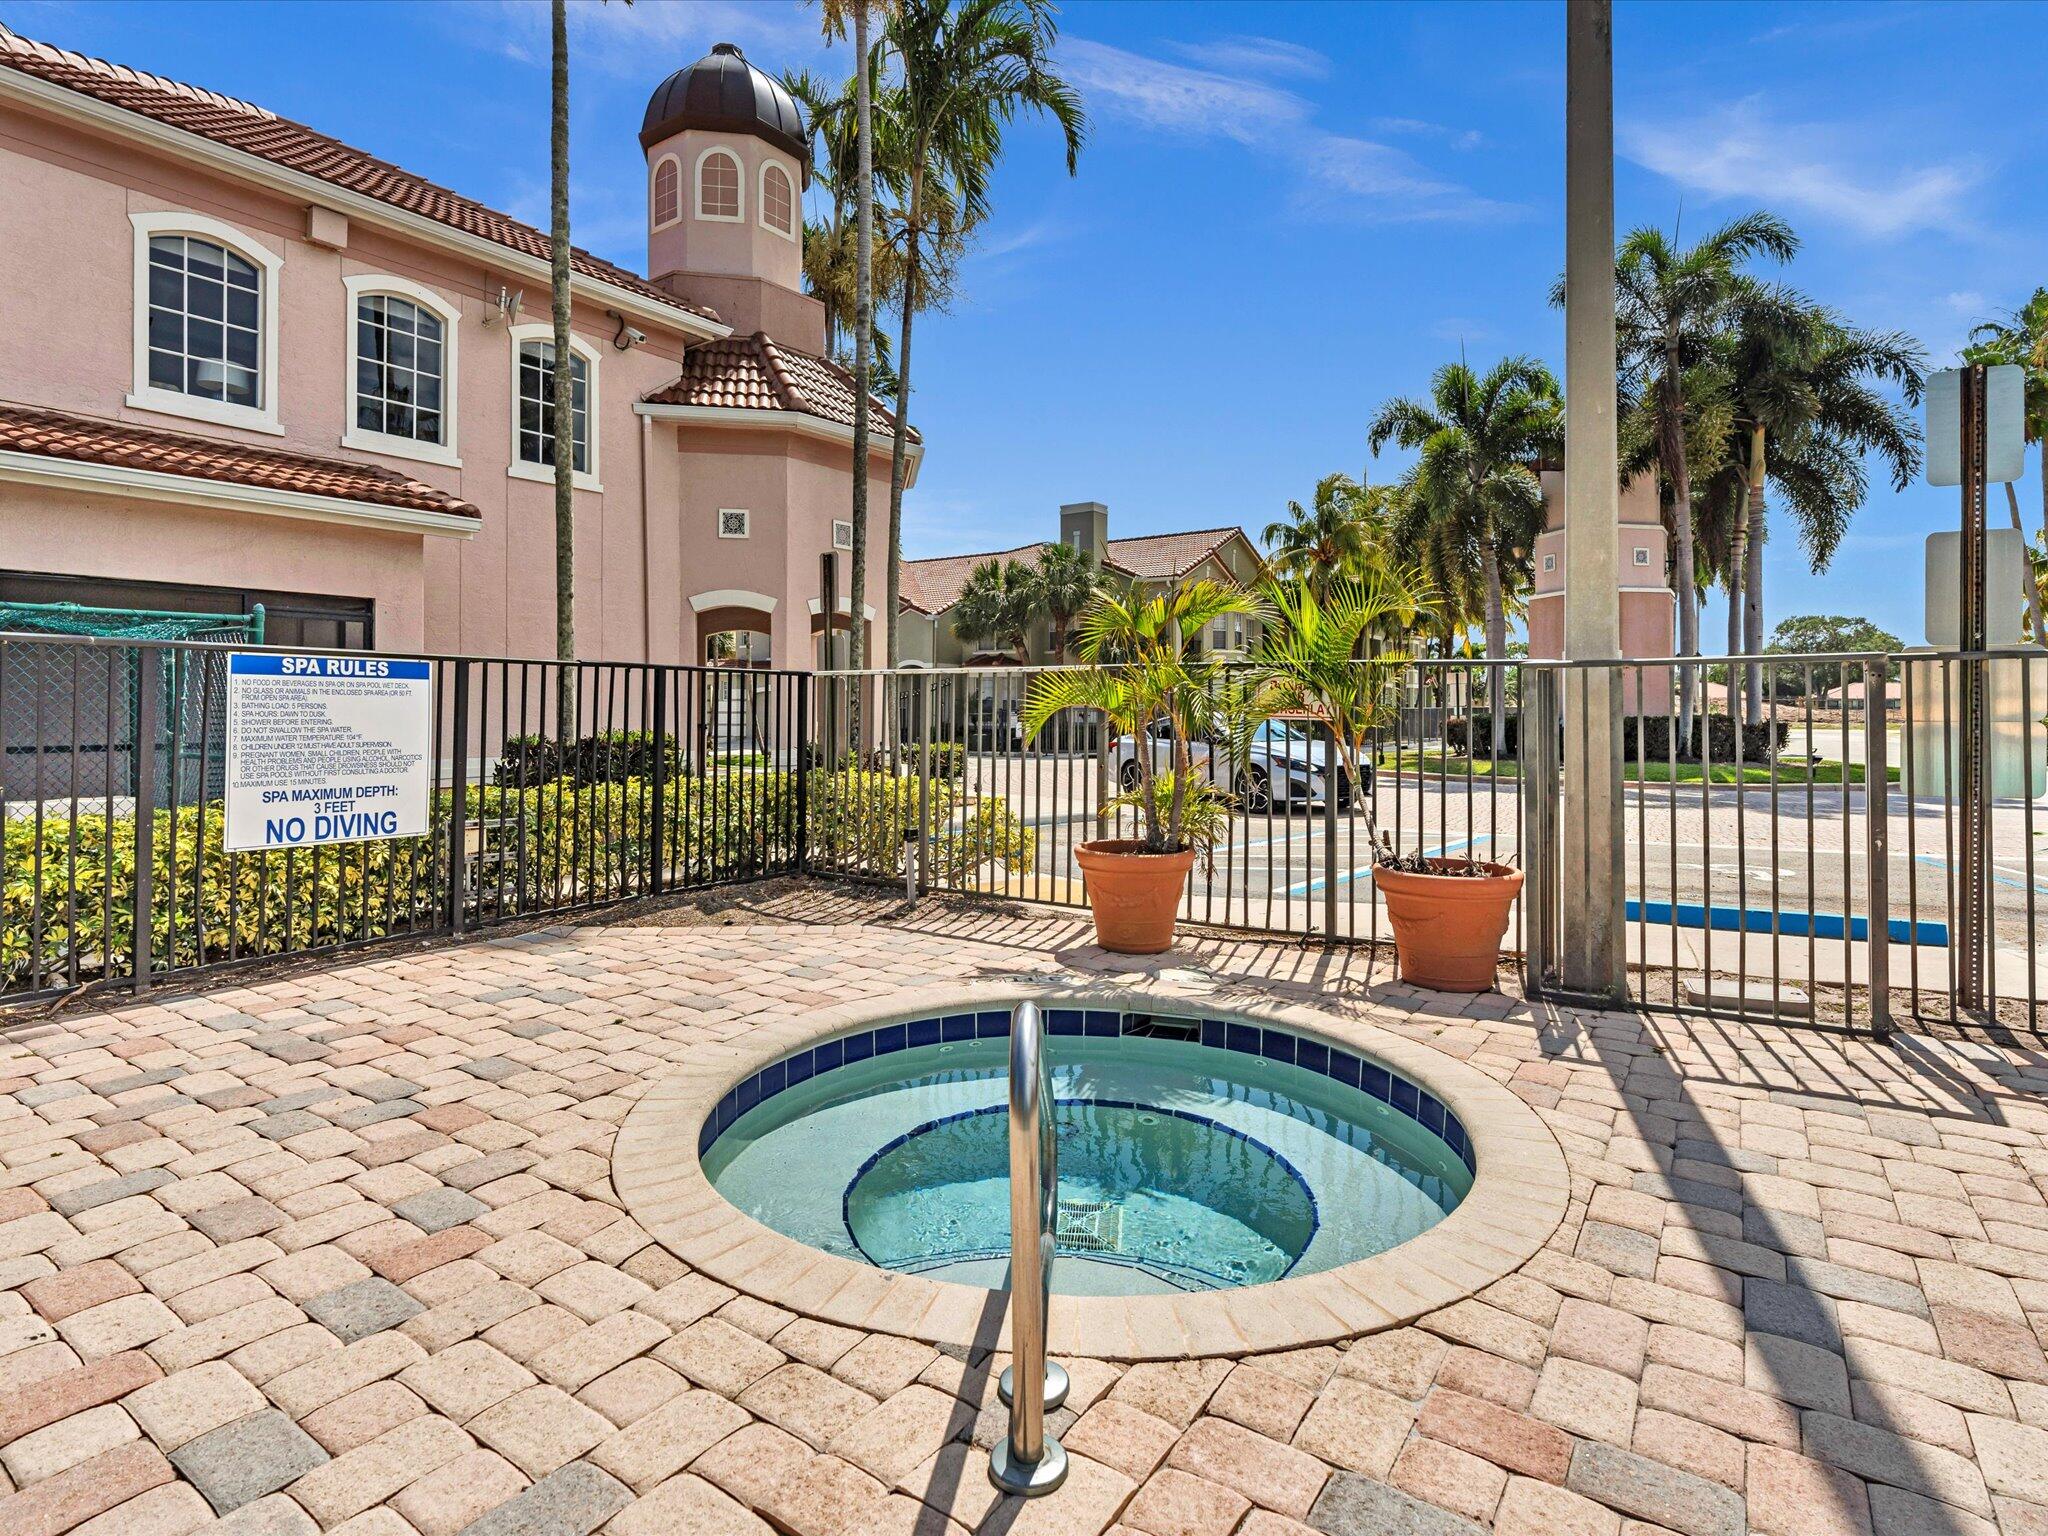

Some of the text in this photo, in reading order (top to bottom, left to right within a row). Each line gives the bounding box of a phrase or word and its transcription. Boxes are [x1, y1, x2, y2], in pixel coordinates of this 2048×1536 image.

[282, 658, 389, 677] SPA RULES
[272, 679, 280, 687] OR
[356, 681, 366, 689] SPA
[240, 780, 273, 788] MAXIMUM
[262, 785, 399, 803] SPA MAXIMUM DEPTH:
[314, 800, 356, 814] 3 FEET
[266, 810, 398, 844] NO DIVING
